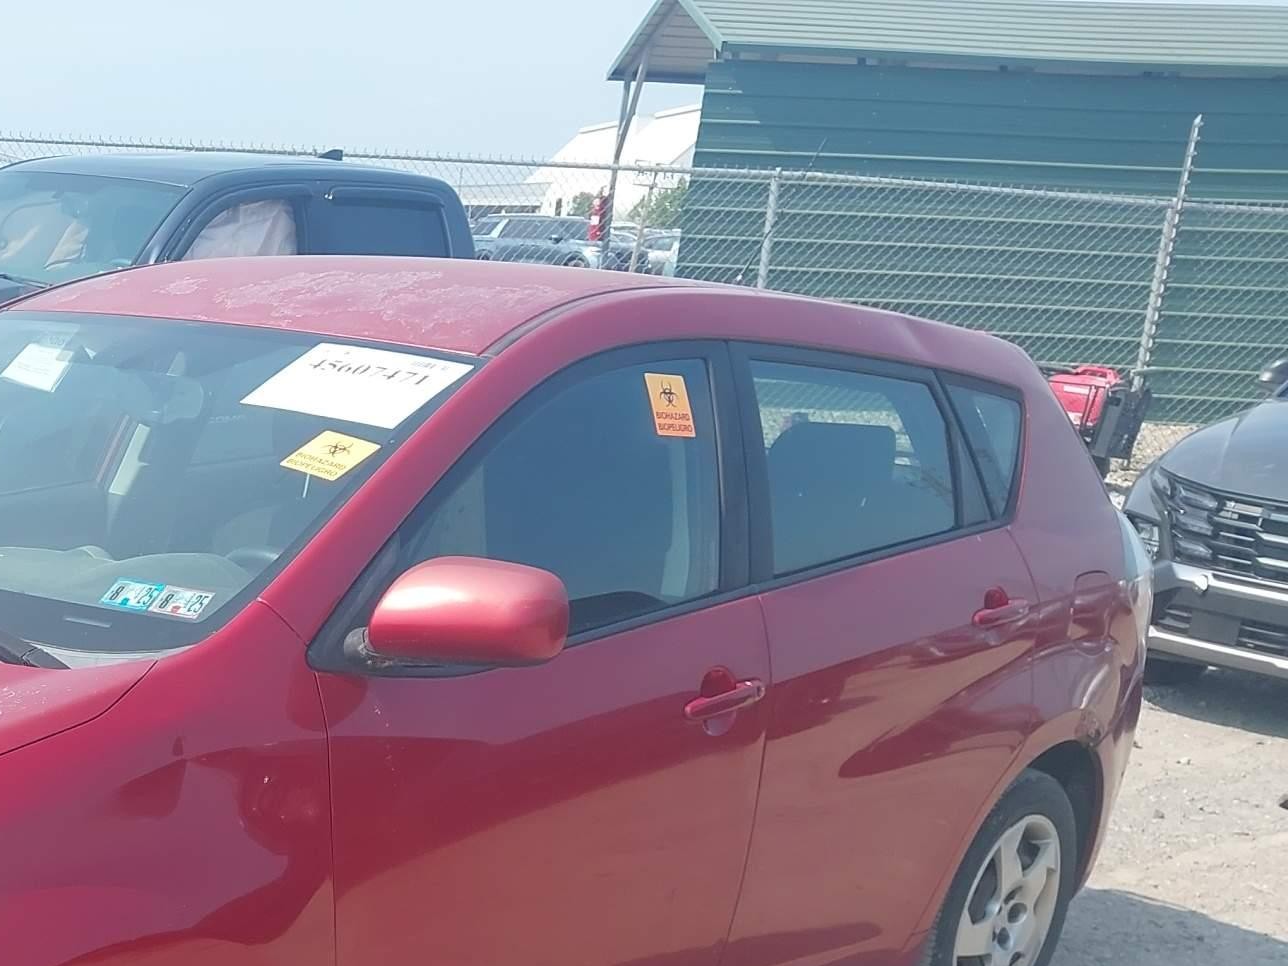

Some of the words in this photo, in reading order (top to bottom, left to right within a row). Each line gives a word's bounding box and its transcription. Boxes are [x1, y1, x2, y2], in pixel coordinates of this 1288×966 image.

[309, 358, 430, 385] 45607471
[655, 411, 690, 421] BIOHAZARD
[657, 423, 693, 432] BIOPELIGRO
[285, 458, 338, 477] BIOPELIGRO
[294, 451, 348, 471] BIOHAZARD
